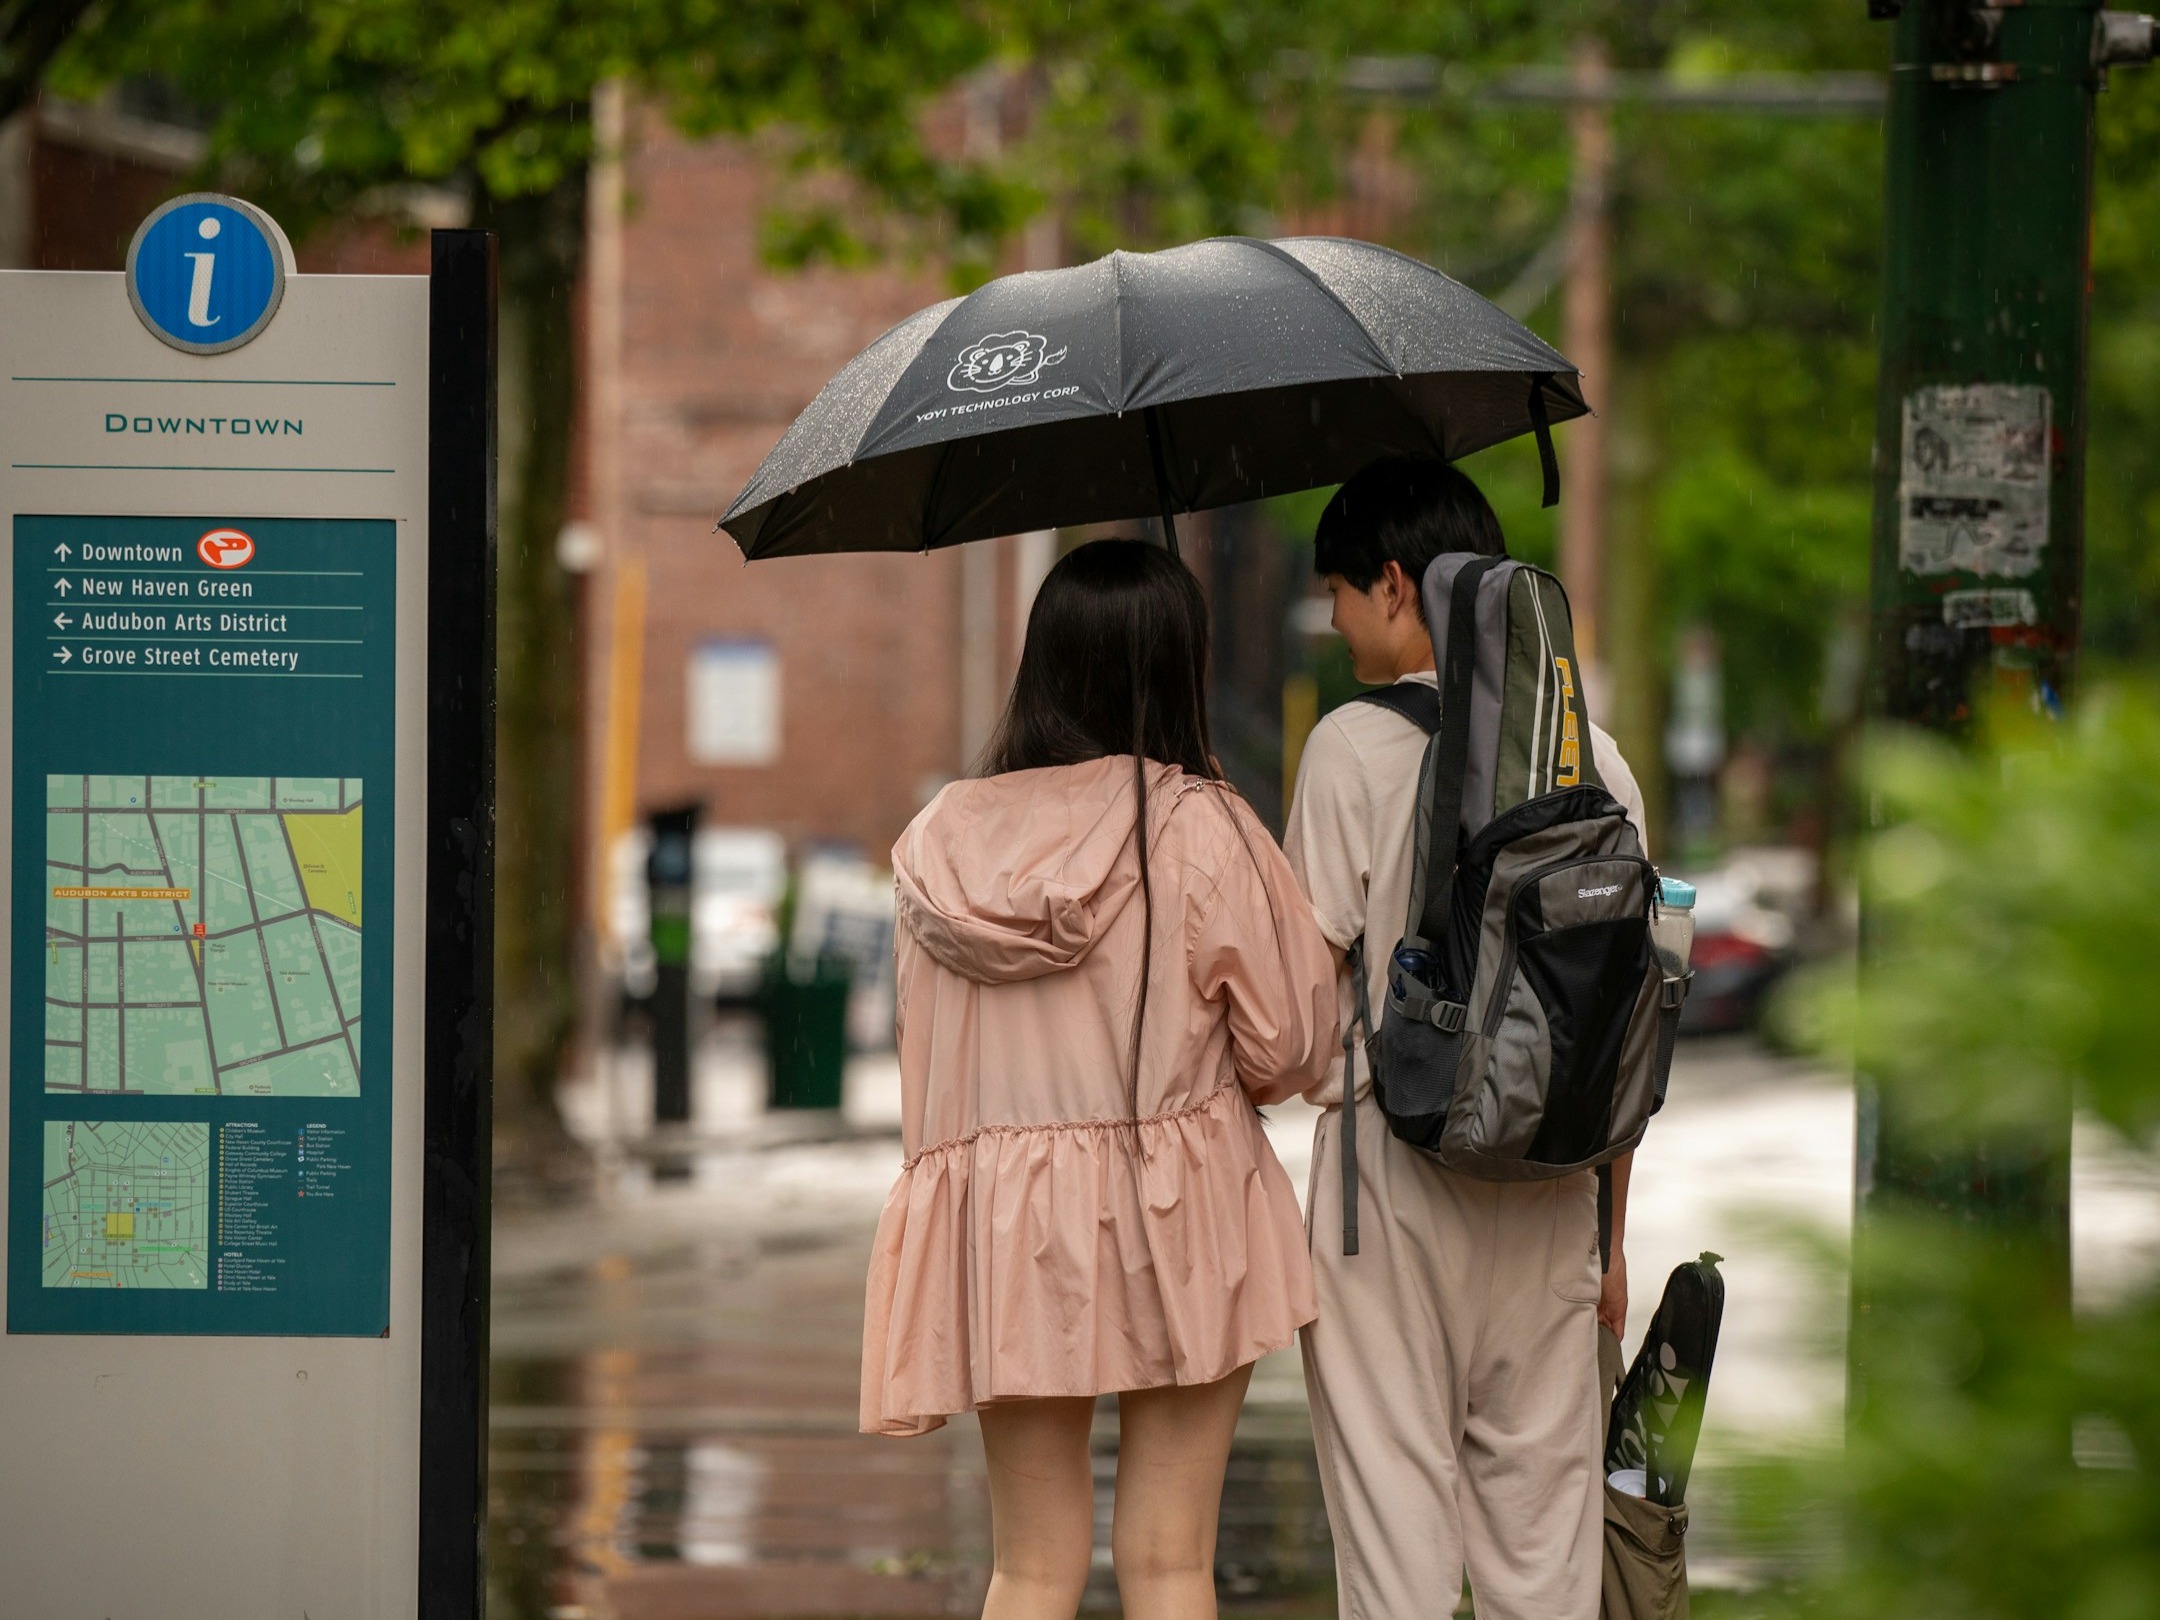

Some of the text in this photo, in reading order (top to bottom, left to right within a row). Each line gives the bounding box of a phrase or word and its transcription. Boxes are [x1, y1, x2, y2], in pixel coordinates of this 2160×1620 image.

[915, 385, 1080, 423] YOYI TECHNOLOGY CORP
[82, 543, 182, 562] Downtown
[82, 578, 253, 598] New Haven Green
[82, 612, 287, 632] Audubon Arts District
[82, 647, 299, 671] Grove Street Cemetery
[54, 889, 107, 897] AUDUBON
[141, 890, 189, 898] DISTRICT
[1578, 884, 1618, 898] Slazenger
